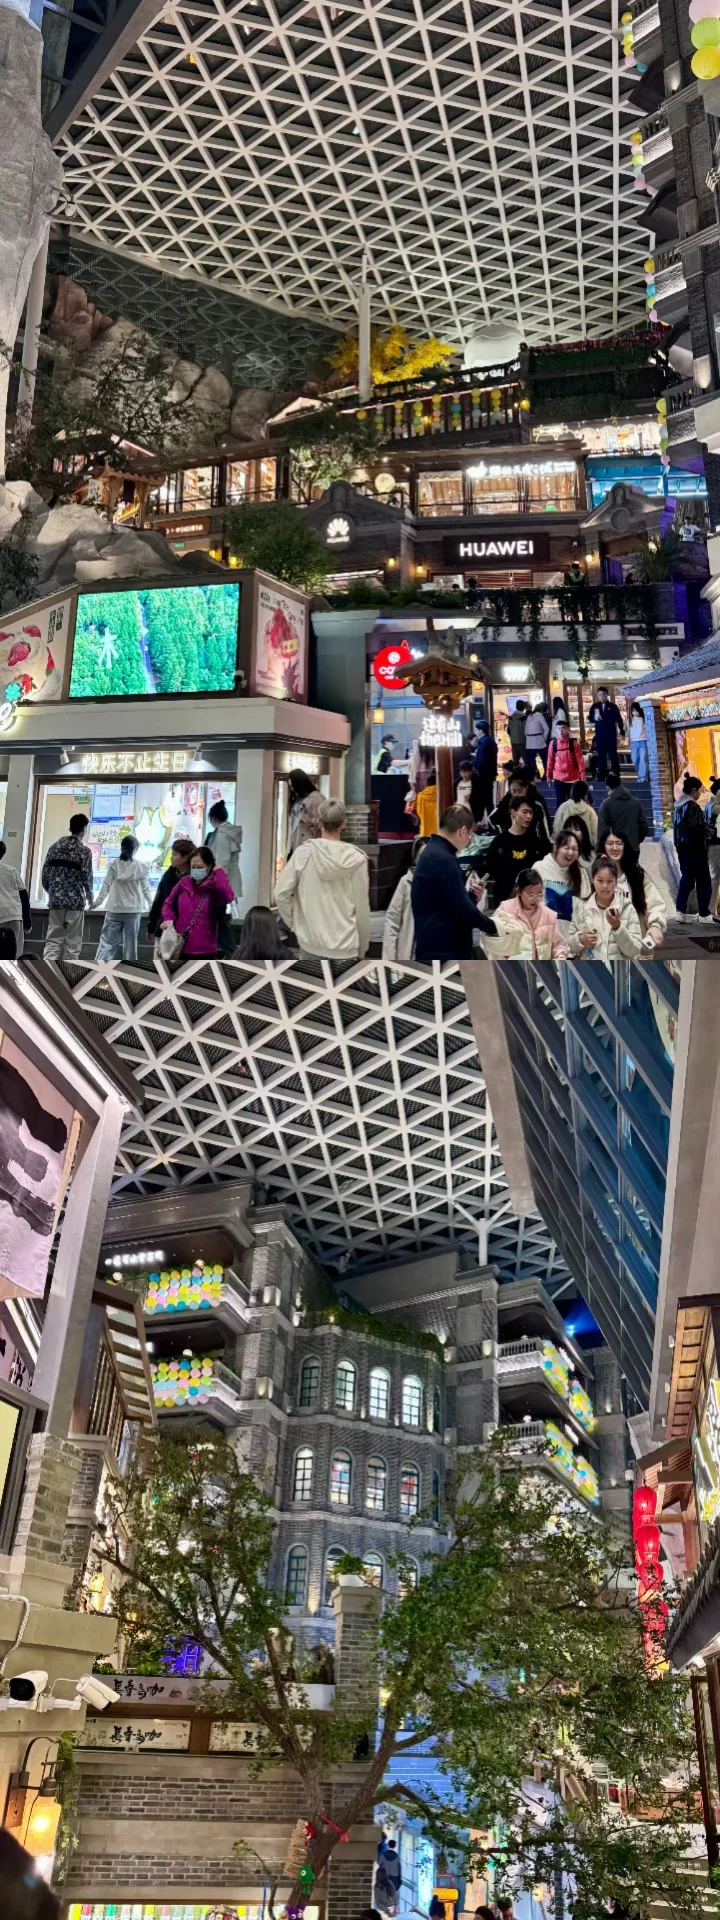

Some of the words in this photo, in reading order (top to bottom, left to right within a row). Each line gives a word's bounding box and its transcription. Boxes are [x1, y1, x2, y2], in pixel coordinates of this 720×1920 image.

[459, 540, 534, 557] HUAWEI
[82, 752, 187, 774] 快乐不止生日
